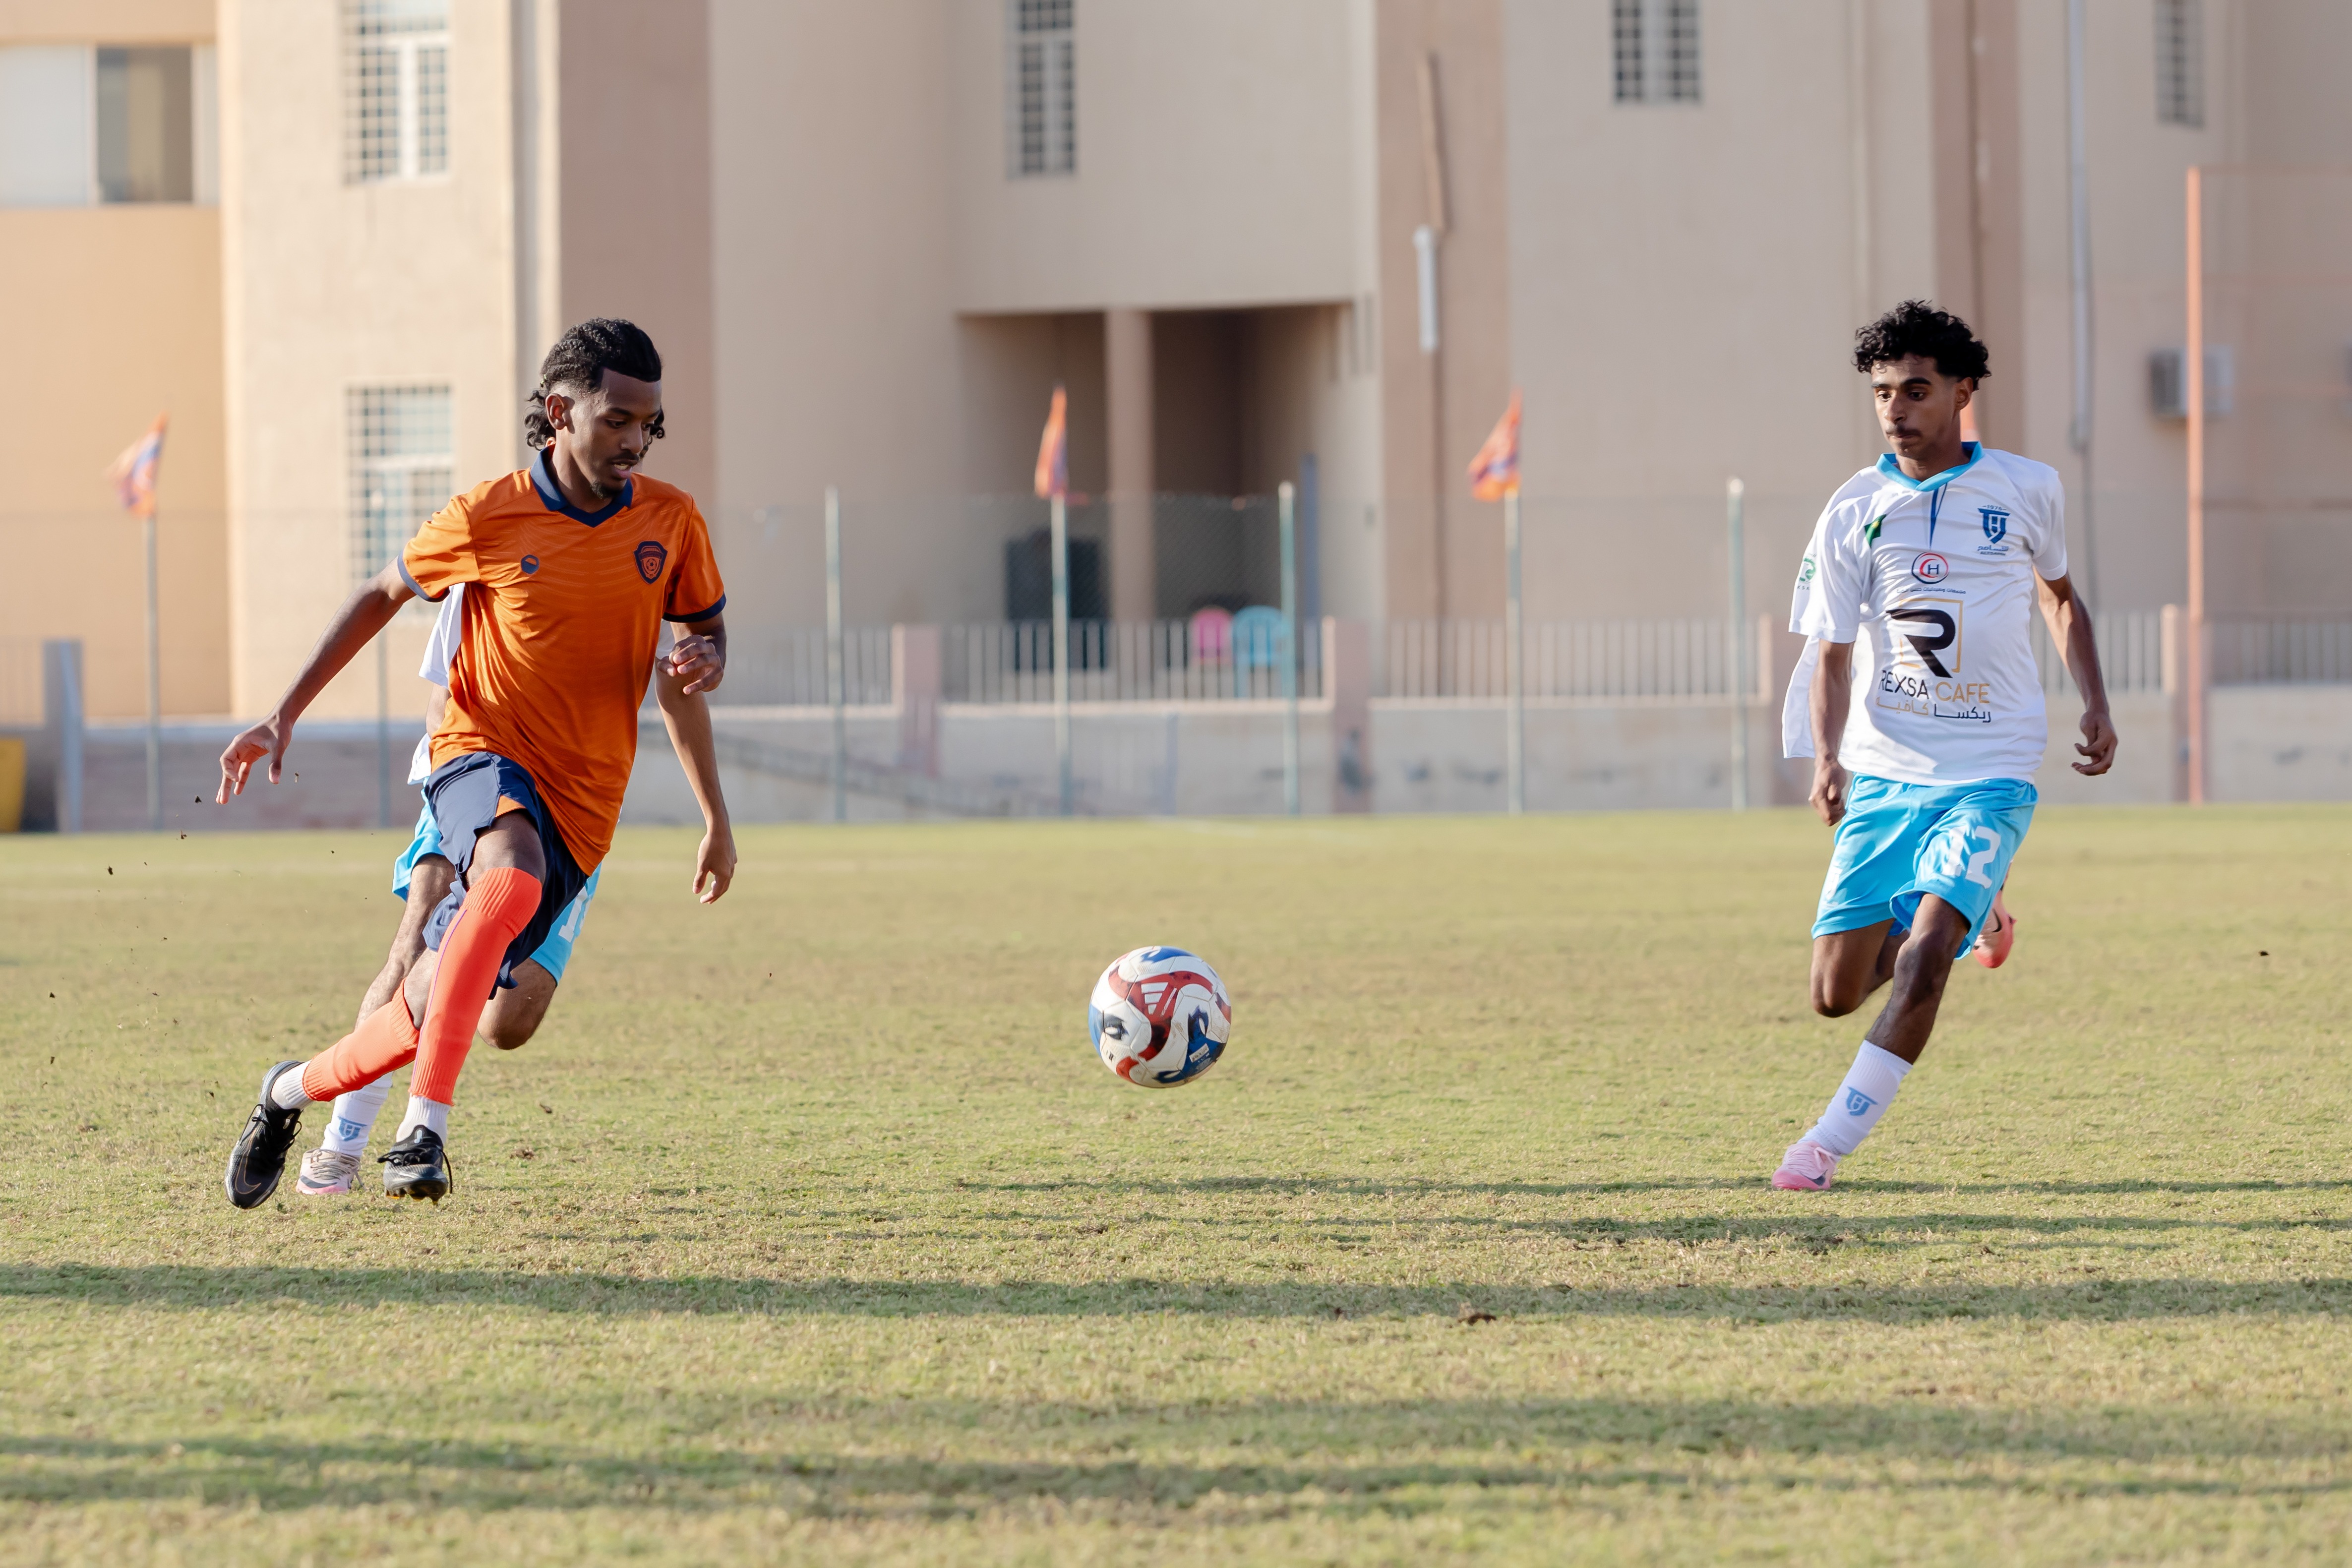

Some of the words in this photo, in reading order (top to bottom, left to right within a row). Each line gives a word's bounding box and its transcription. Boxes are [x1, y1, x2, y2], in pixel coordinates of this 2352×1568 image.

[1935, 681, 1990, 704] CAFE
[1934, 703, 1991, 724] ريكسا
[1941, 826, 2001, 889] 12
